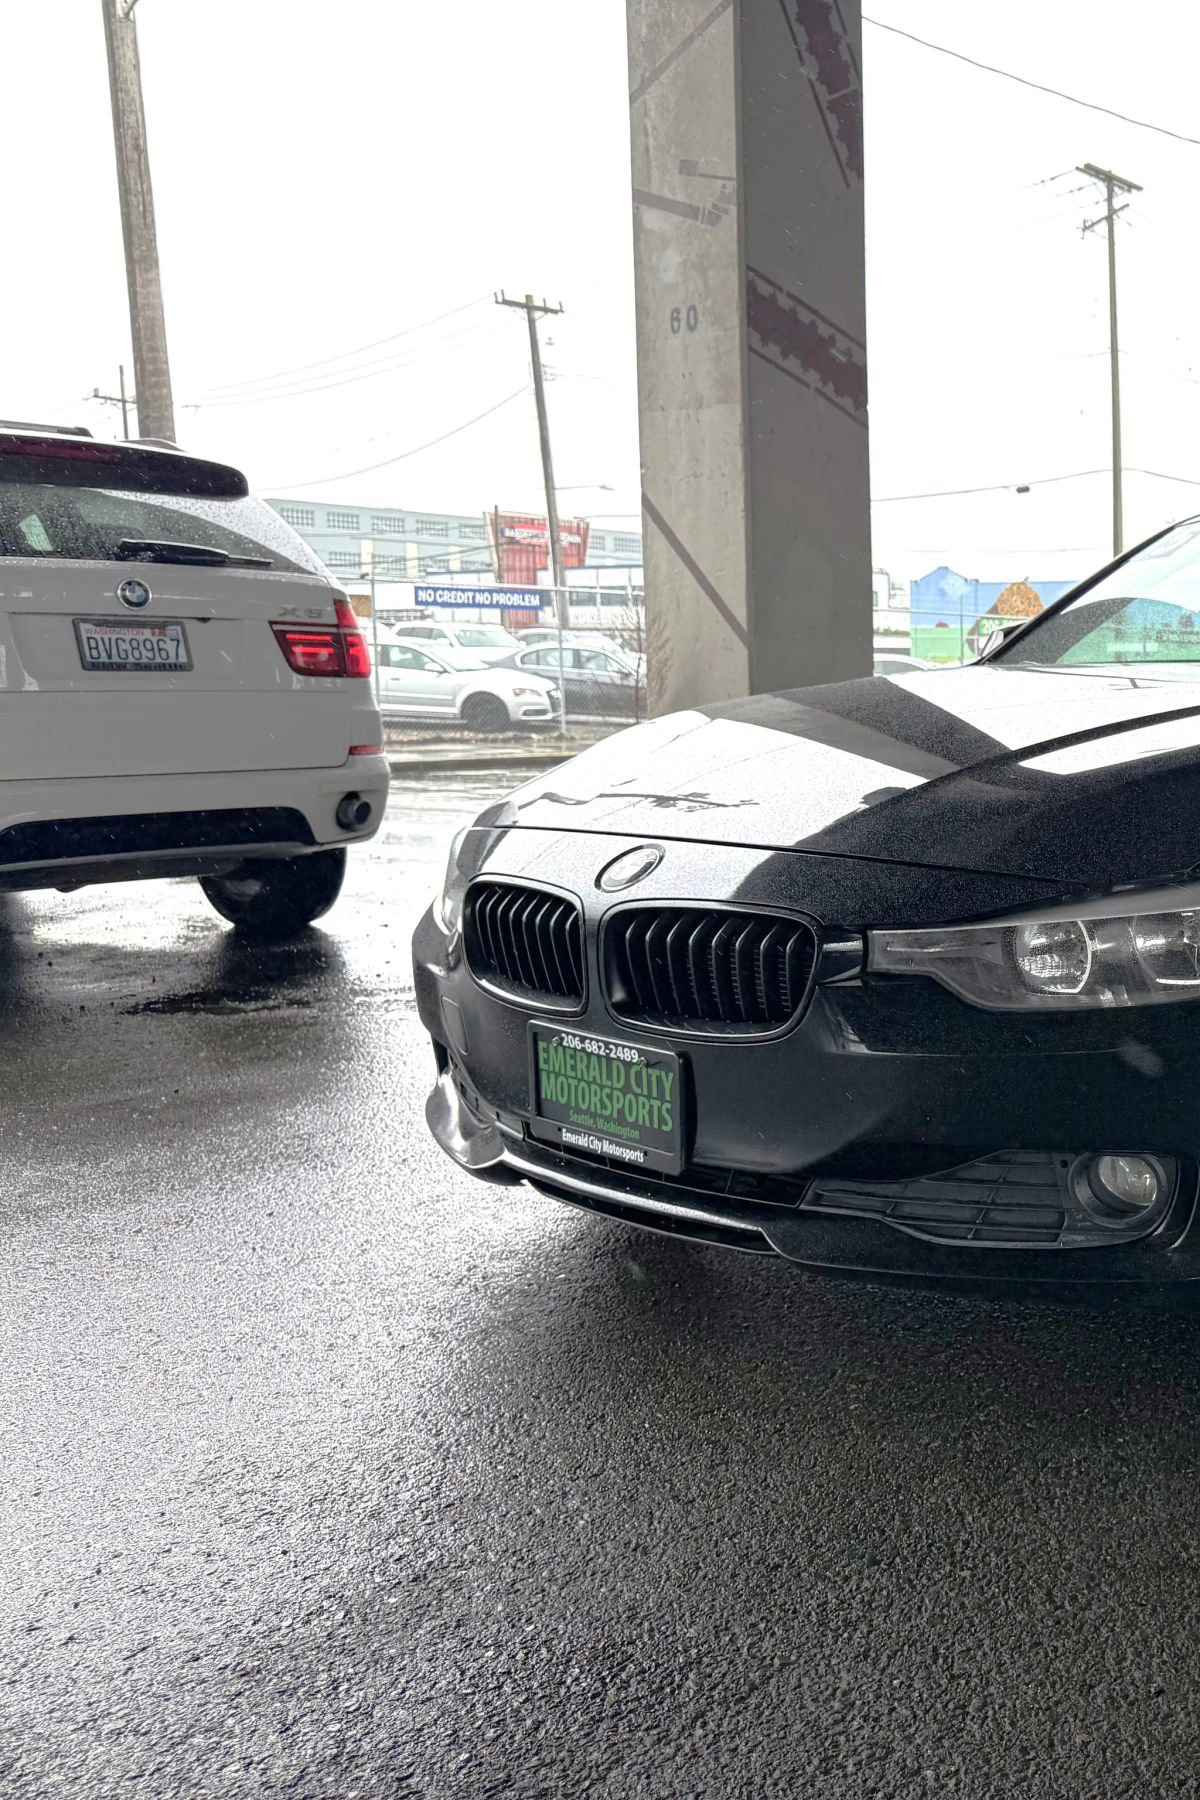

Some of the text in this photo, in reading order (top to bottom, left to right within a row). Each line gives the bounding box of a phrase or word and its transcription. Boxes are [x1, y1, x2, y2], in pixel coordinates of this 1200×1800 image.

[669, 303, 699, 335] 60
[417, 589, 540, 607] NO CREDIT NO PROBLEM
[85, 627, 144, 637] WASHINGTON
[86, 636, 180, 661] BVG8967
[560, 1033, 639, 1063] 206-682-2489
[538, 1040, 674, 1101] EMERALD CITY
[541, 1070, 673, 1132] MOTORSPORTS
[569, 1109, 640, 1140] Seattle, Washington
[562, 1128, 644, 1163] Emerald City Motorsports
